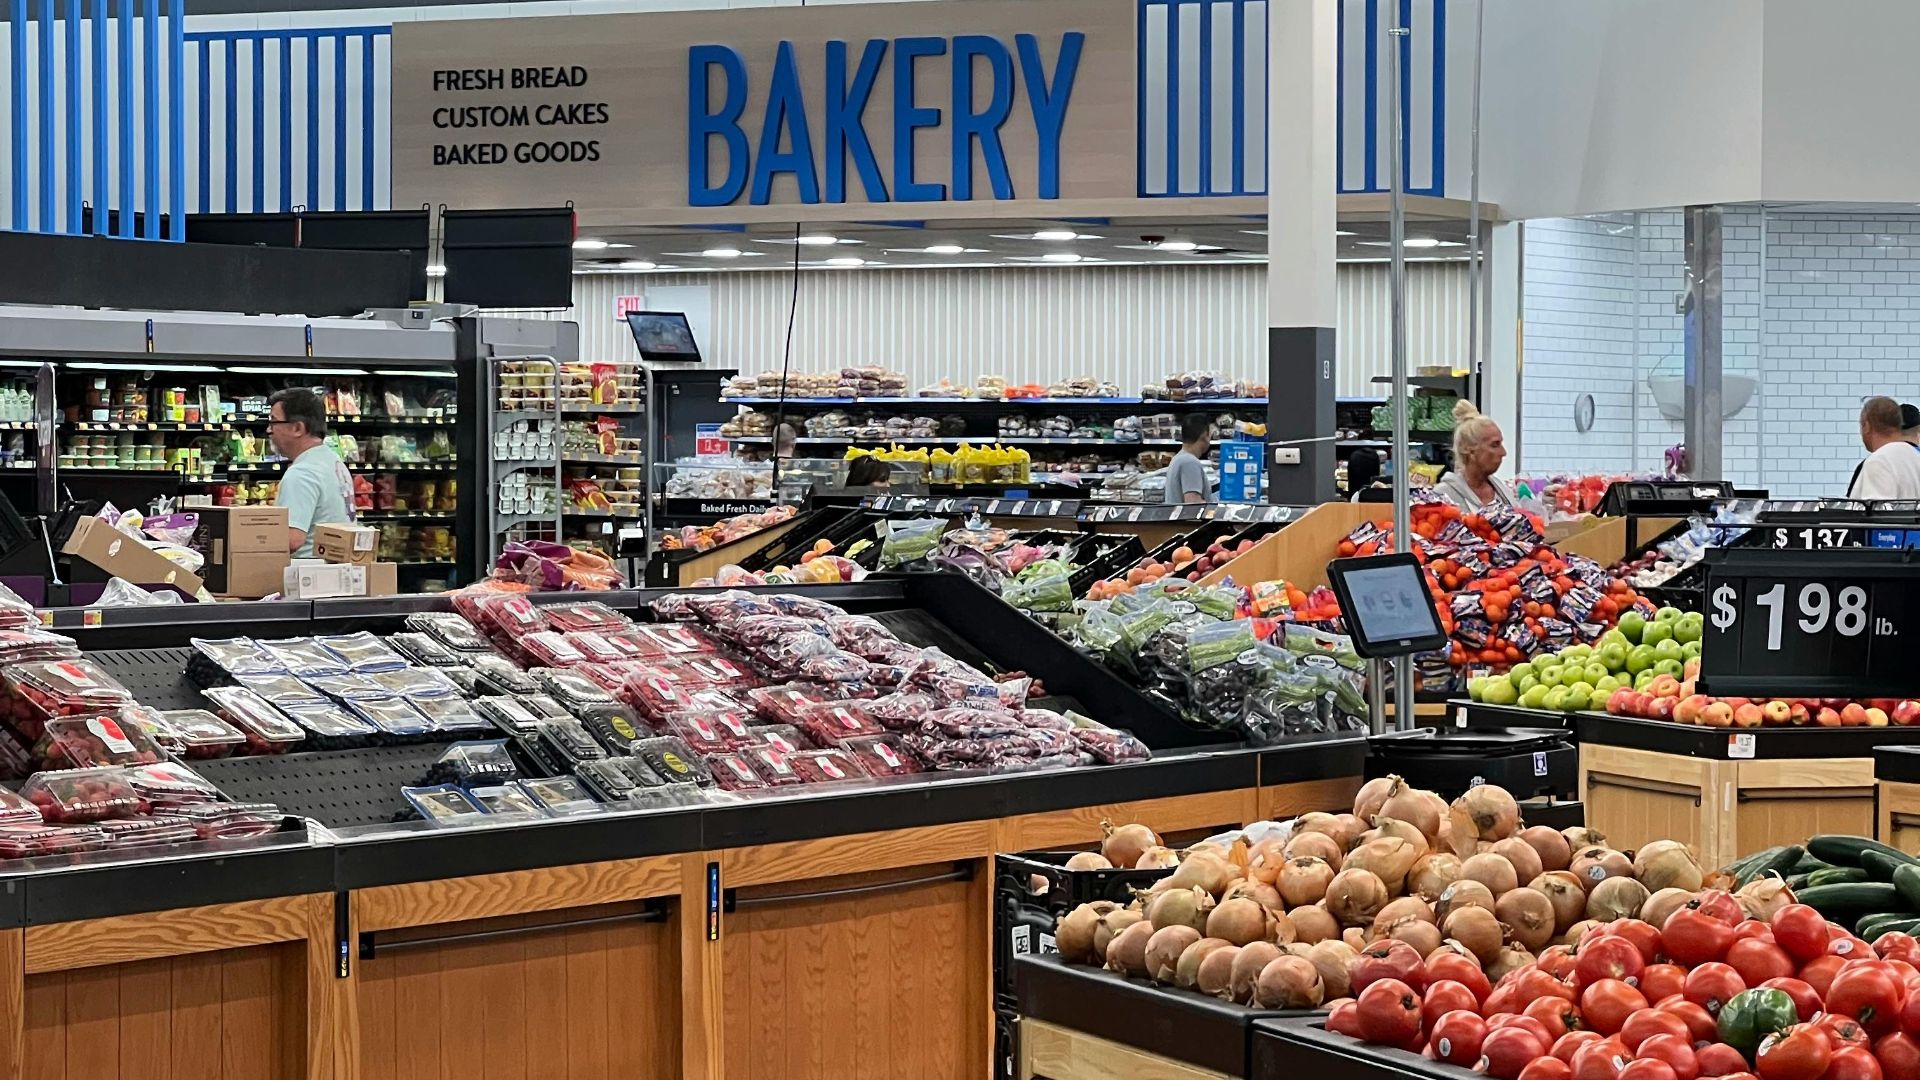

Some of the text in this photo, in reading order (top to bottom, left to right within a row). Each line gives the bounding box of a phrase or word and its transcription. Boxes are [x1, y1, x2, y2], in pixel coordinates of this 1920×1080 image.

[433, 65, 588, 91] FRESH BREAD
[432, 102, 609, 129] CUSTOM CAKES
[688, 31, 1086, 207] BAKERY
[433, 140, 600, 166] BAKED GOODS
[701, 503, 725, 514] Baked
[725, 503, 748, 514] Fresh
[1711, 582, 1899, 650] $ 198 lb.
